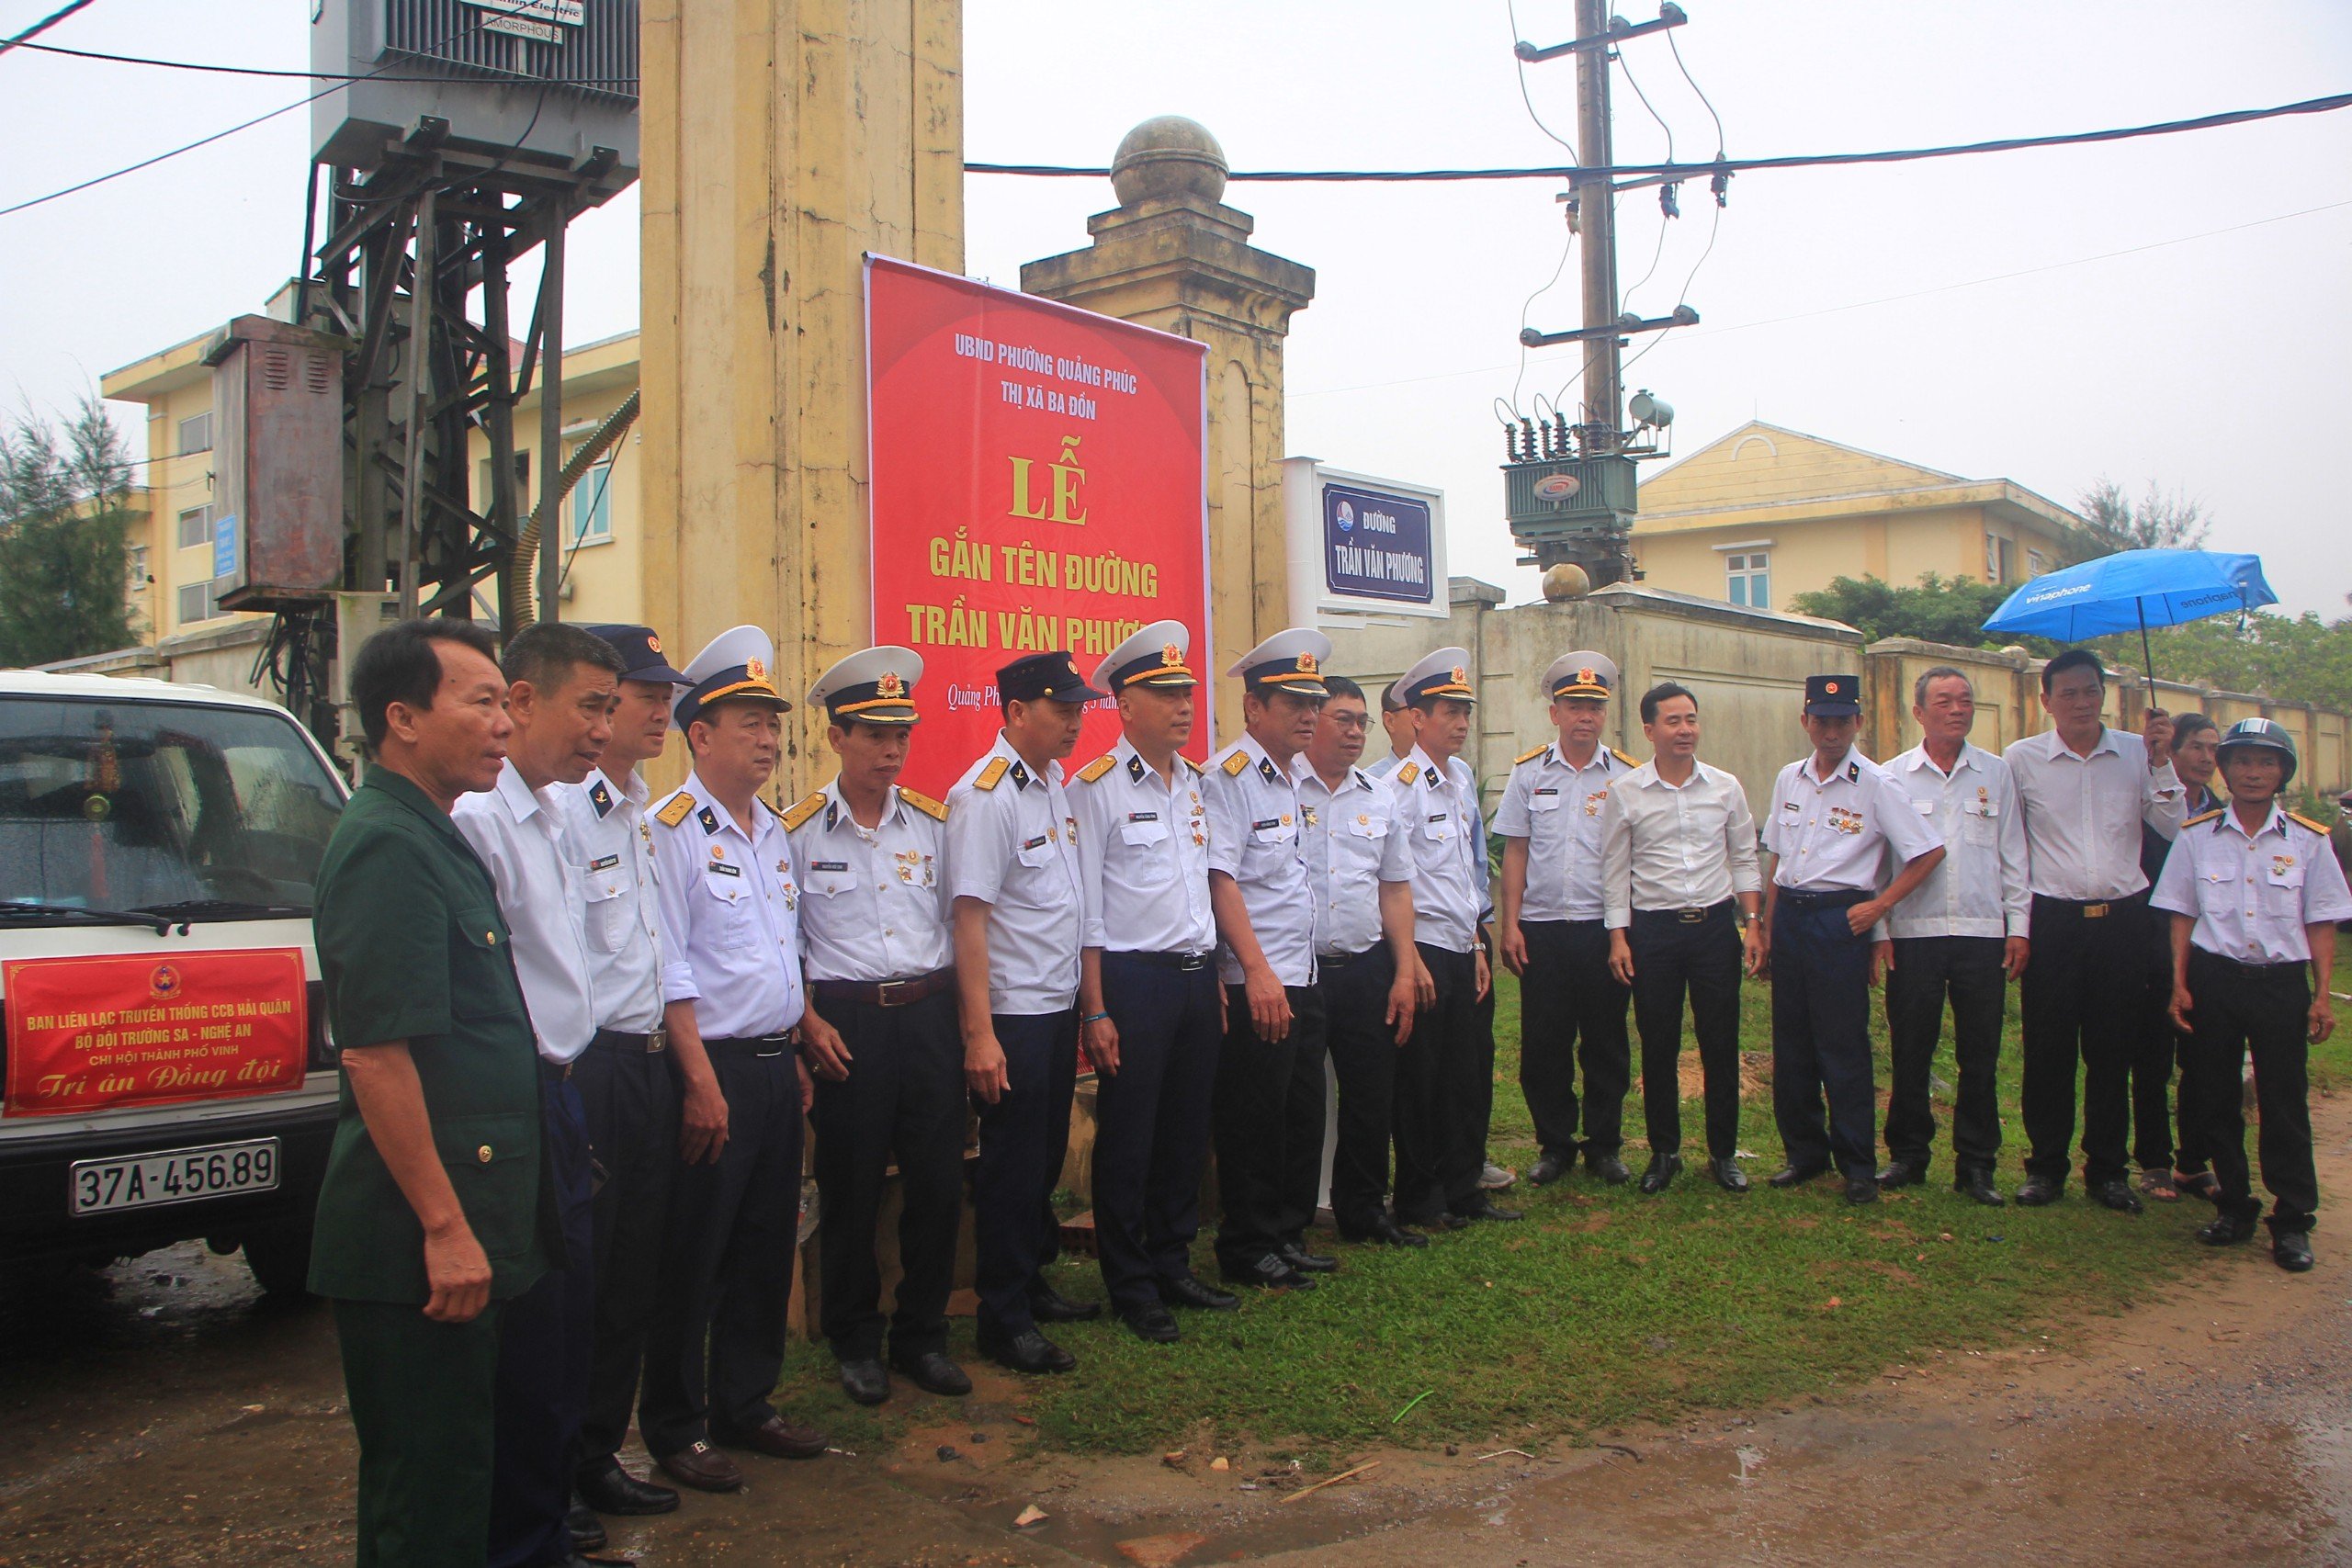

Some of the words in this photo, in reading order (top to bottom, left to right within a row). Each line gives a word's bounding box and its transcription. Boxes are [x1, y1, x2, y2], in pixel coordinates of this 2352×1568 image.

[487, 17, 559, 39] AMORPHOUS
[955, 333, 994, 362] UBND
[998, 344, 1053, 376] PHƯỜNG
[1057, 355, 1101, 387] QUẢNG
[1104, 368, 1136, 395] PHÚC
[1001, 380, 1023, 410] THỊ
[1026, 384, 1044, 410] XÃ
[1047, 390, 1065, 414] BA
[1069, 391, 1096, 421] ĐỒN
[1008, 435, 1088, 525] LỄ
[1363, 510, 1396, 534] ĐƯỜNG
[929, 525, 991, 581] GẮN
[1001, 540, 1057, 588] TÊN
[1064, 550, 1159, 599] ĐƯỜNG
[1335, 536, 1363, 577] TRẦN
[1363, 543, 1385, 580] VĂN
[1385, 551, 1424, 584] PHƯƠNG
[2025, 583, 2092, 604] vinaphone
[905, 594, 988, 649] TRẦN
[998, 605, 1058, 652] VĂN
[947, 683, 981, 712] Quảng
[27, 1015, 54, 1031] BAN
[58, 1011, 88, 1029] LIÊN
[91, 1011, 116, 1029] LẠC
[119, 1005, 165, 1024] TRUYỀN
[169, 1001, 209, 1021] THỐNG
[211, 1004, 234, 1018] CCB
[238, 998, 257, 1017] HẢI
[260, 998, 291, 1016] QUÂN
[75, 1032, 93, 1052] BỘ
[96, 1030, 118, 1050] ĐỘI
[121, 1027, 170, 1046] TRƯỜNG
[174, 1028, 189, 1042] SA
[200, 1021, 232, 1042] NGHỆ
[234, 1023, 252, 1037] AN
[89, 1055, 111, 1066] CHI
[115, 1050, 138, 1066] HỘI
[141, 1048, 180, 1061] THÀNH
[184, 1043, 209, 1058] PHỐ
[211, 1045, 239, 1056] VINH
[37, 1074, 86, 1099] Tri
[97, 1073, 135, 1093] ân
[147, 1063, 228, 1090] Đồng
[237, 1058, 281, 1084] đội
[79, 1148, 273, 1208] 37A-456.89
